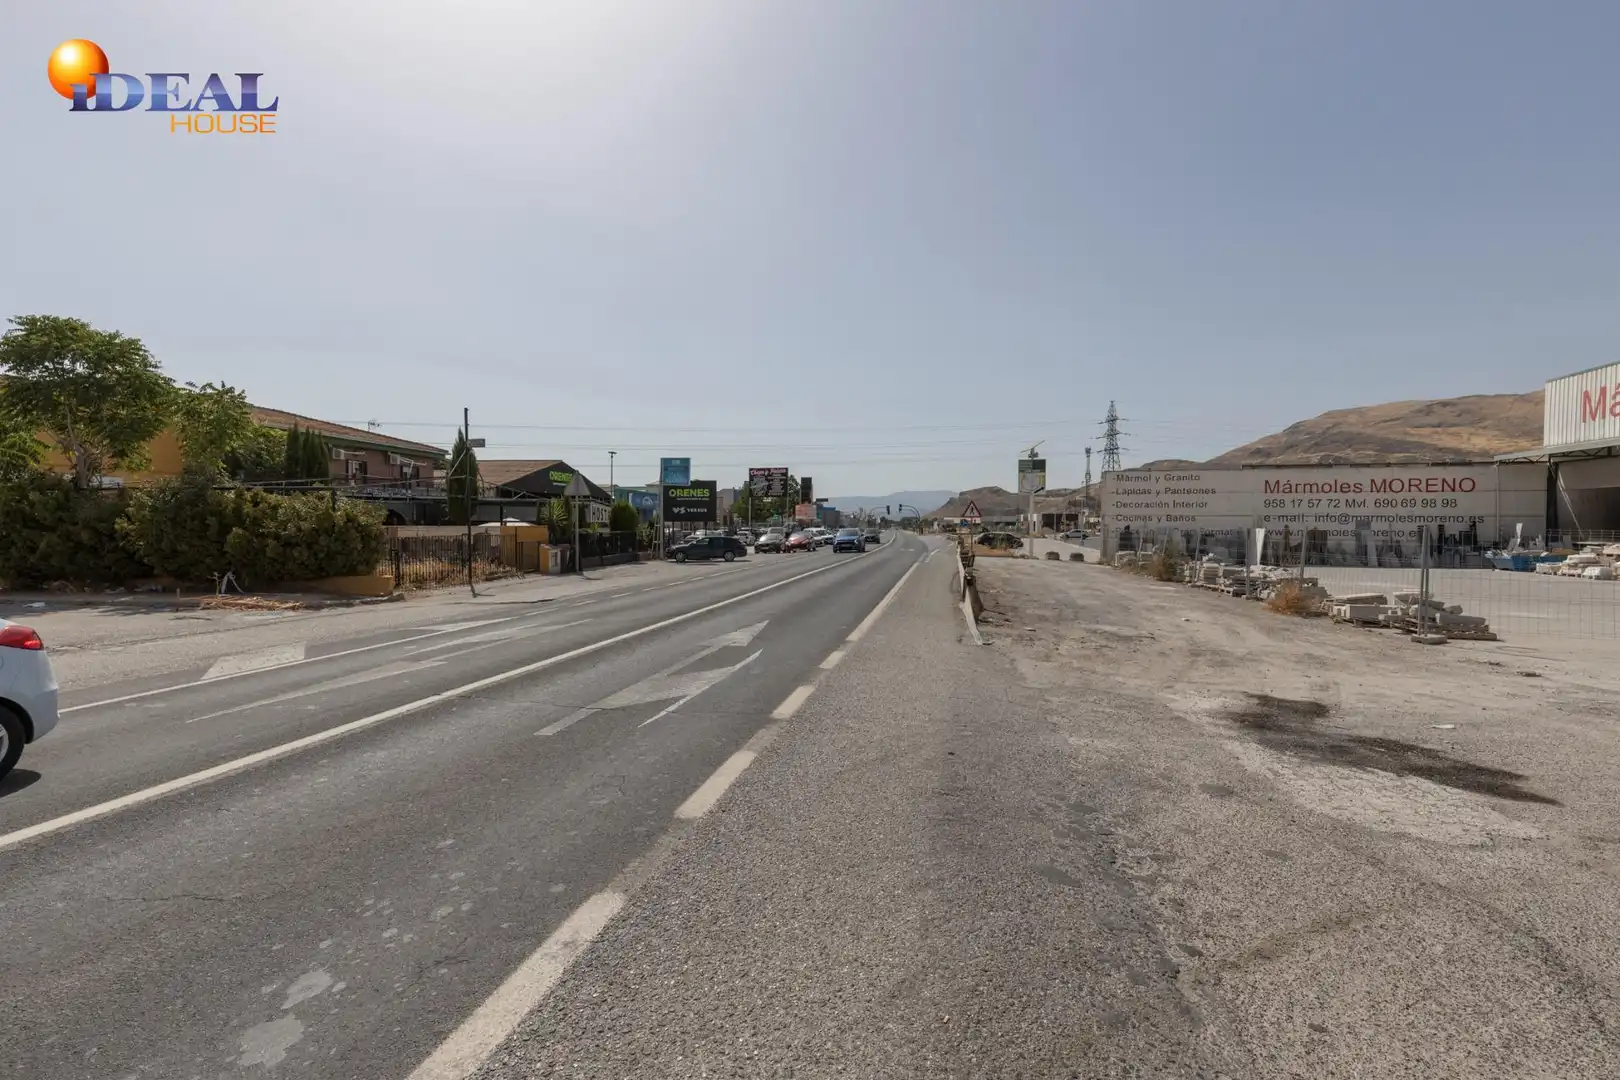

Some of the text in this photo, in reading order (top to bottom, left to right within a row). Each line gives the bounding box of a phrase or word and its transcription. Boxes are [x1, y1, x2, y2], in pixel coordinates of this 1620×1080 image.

[1164, 473, 1200, 482] Granito
[1264, 477, 1476, 494] Mármoles MORENO
[668, 488, 710, 497] ORENES
[1164, 487, 1216, 495] Panteones
[1173, 500, 1208, 508] Interior
[1263, 498, 1457, 508] 958 17 57 72 Mvl. 690 69 98 98
[591, 505, 609, 521] HOST
[1166, 514, 1196, 522] Baños
[1263, 513, 1485, 525] e-mail: info@marmolesmoreno.es
